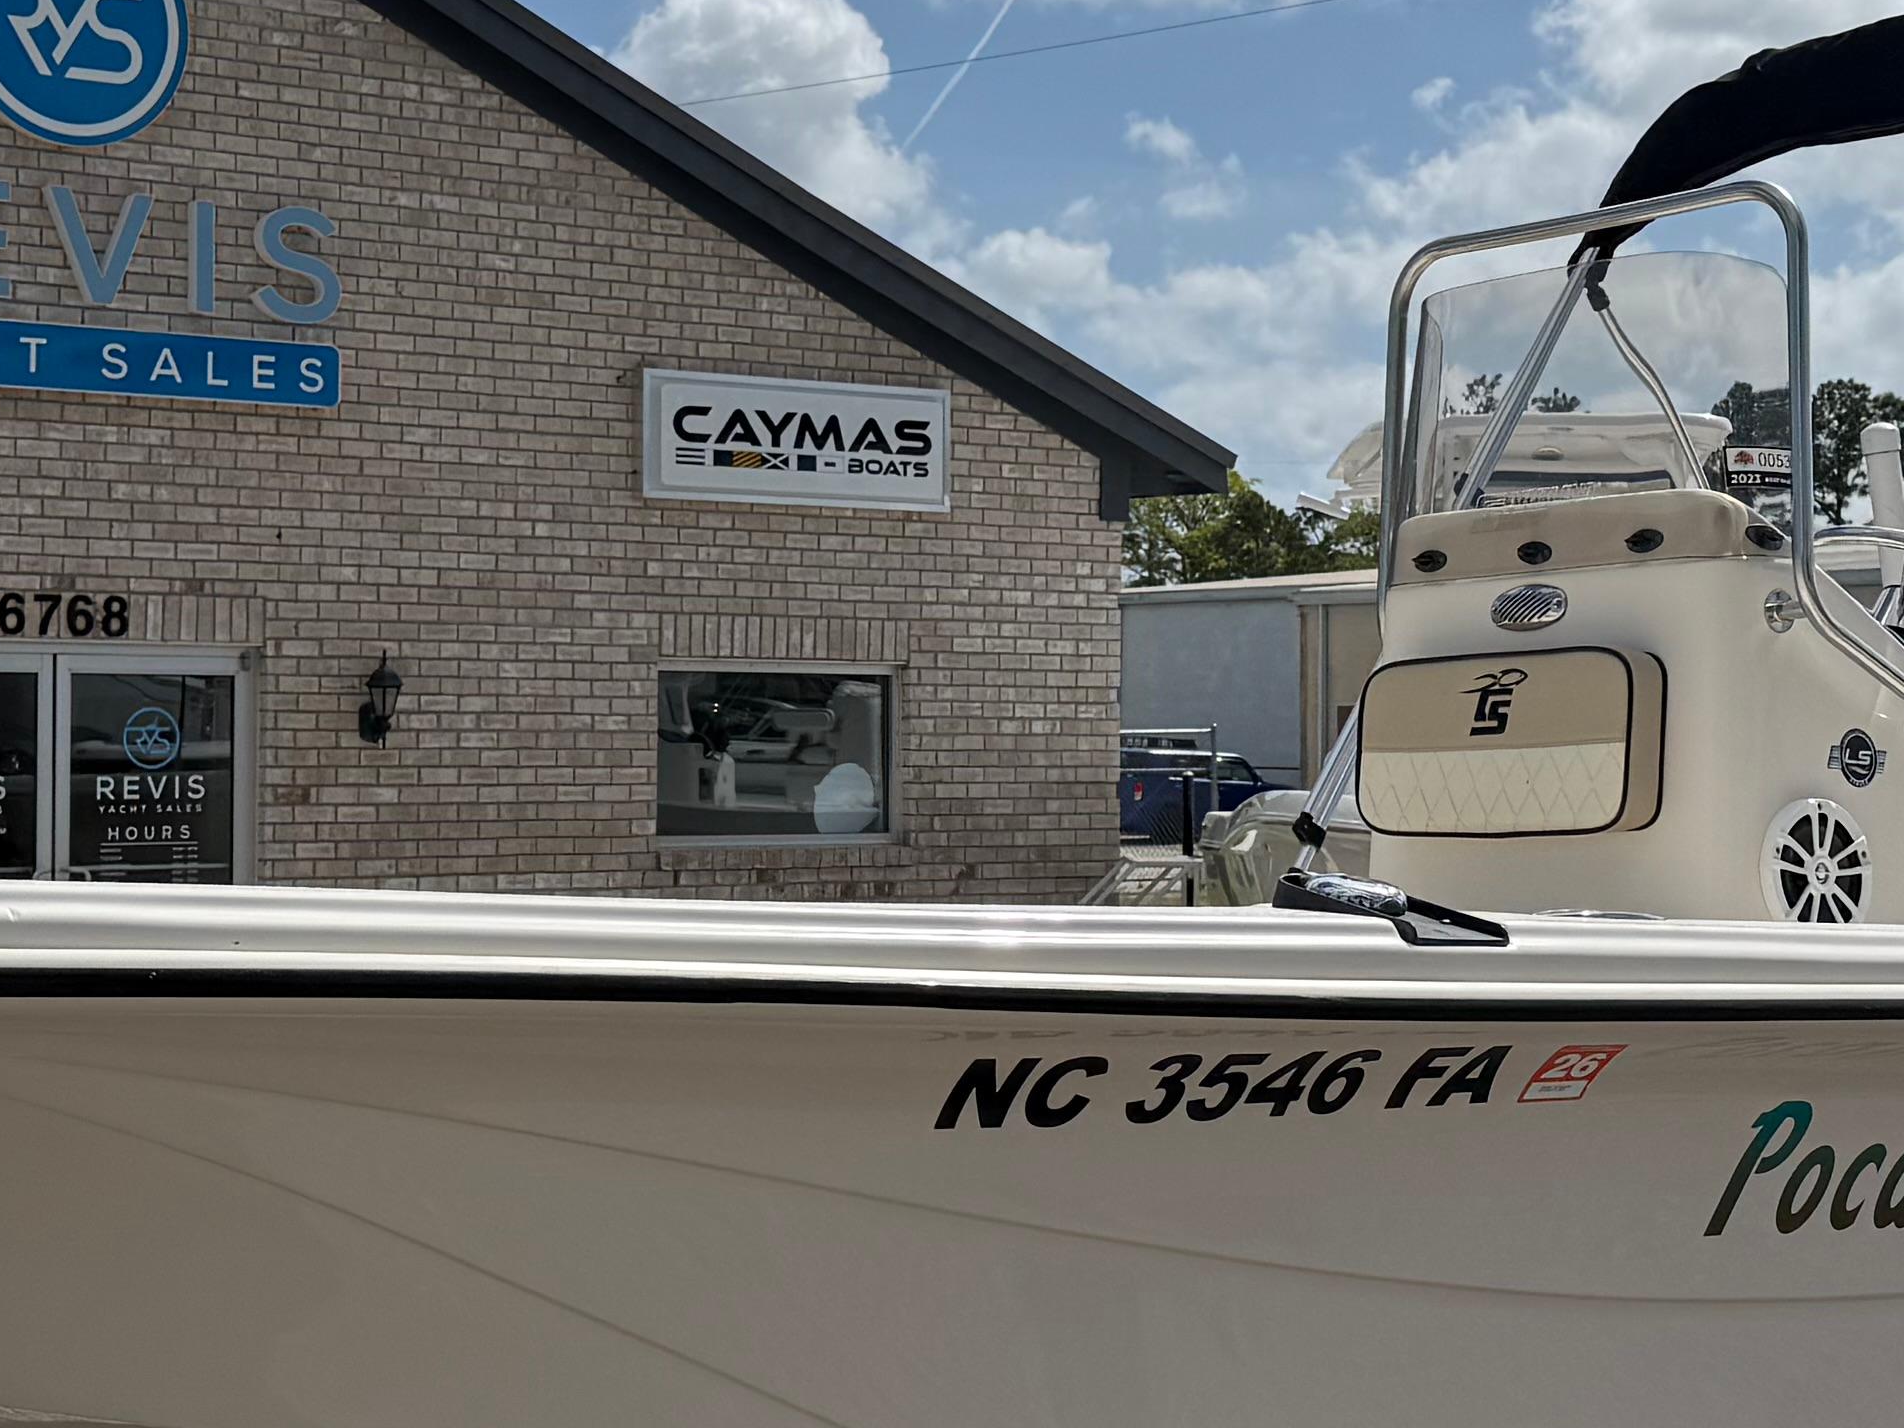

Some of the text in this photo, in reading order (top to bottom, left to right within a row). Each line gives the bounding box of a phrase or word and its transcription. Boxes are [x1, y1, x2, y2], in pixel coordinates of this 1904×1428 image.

[100, 342, 326, 393] SALES
[672, 405, 932, 456] CAYMAS
[847, 458, 929, 478] BOATS
[96, 774, 206, 801] REVIS
[98, 803, 203, 814] YACHT SALES
[107, 825, 191, 841] HOURS
[1540, 1053, 1607, 1079] 26
[934, 1044, 1513, 1130] NC 3546 FA
